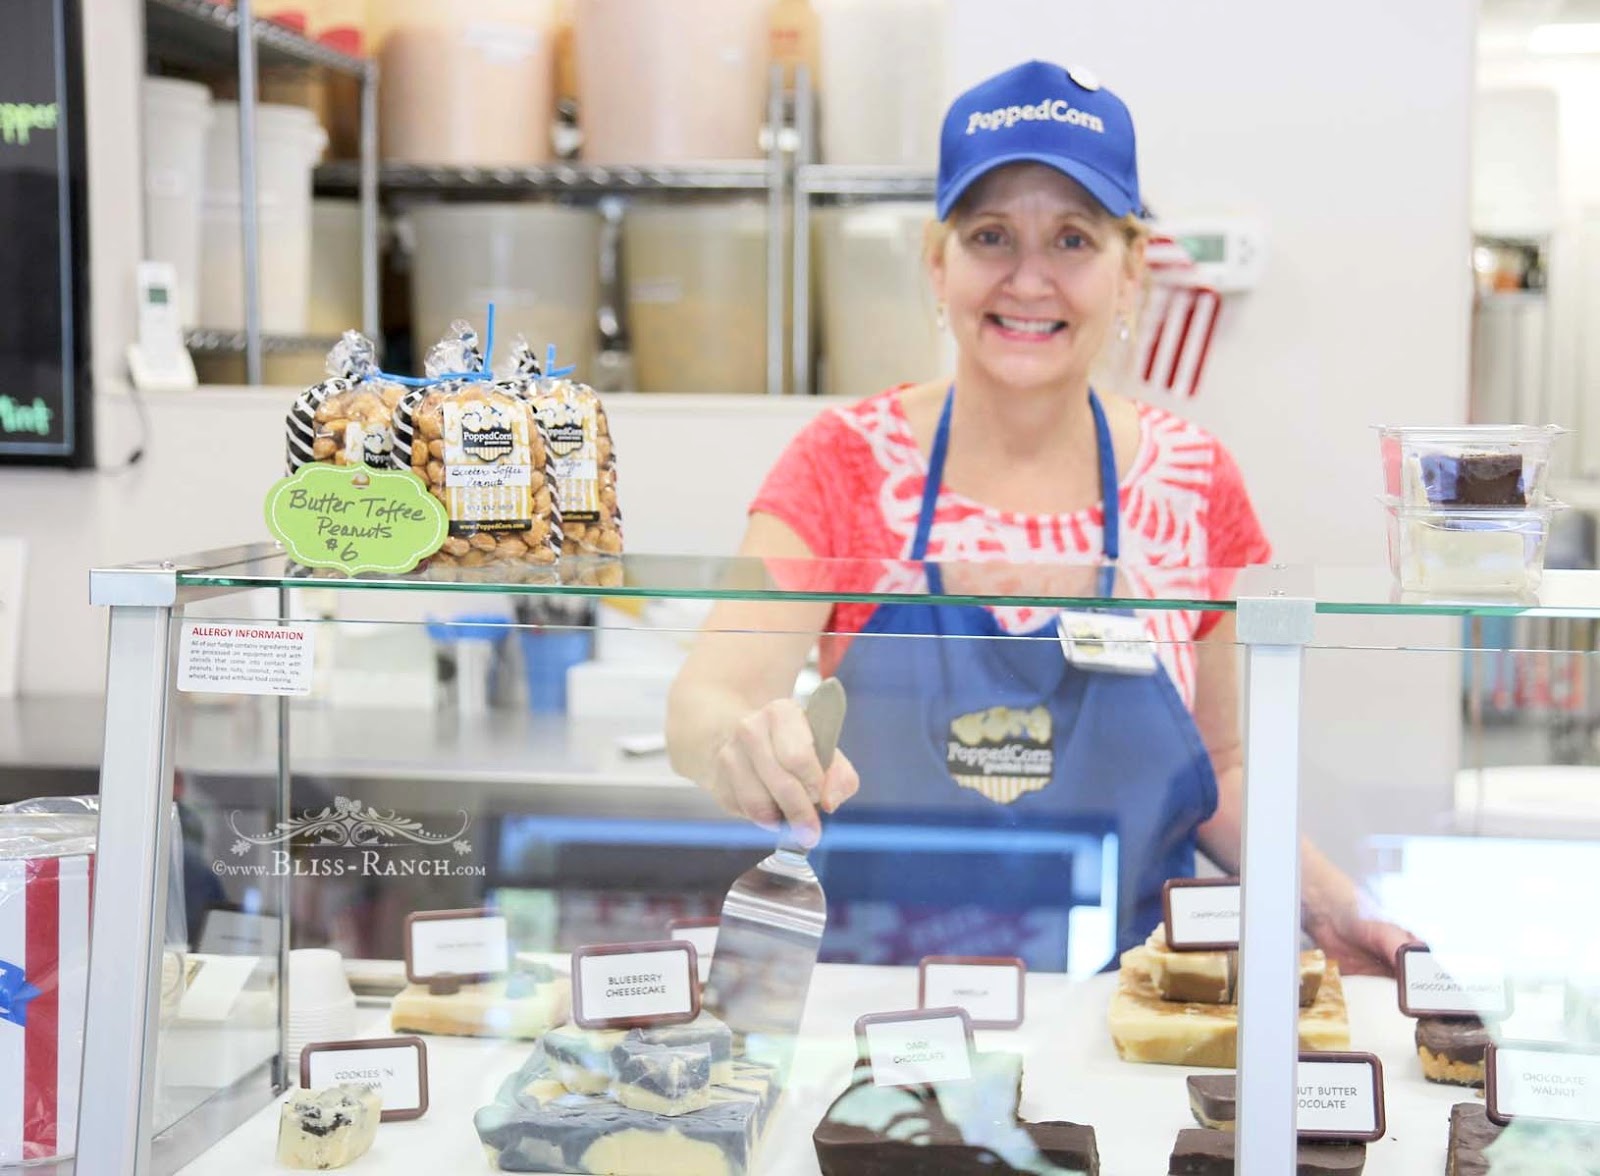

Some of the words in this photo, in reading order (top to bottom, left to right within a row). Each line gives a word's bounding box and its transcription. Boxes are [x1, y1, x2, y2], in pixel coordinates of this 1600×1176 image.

[966, 98, 1105, 134] PoppedCorn
[0, 103, 57, 144] pper
[463, 431, 513, 442] PoppedCorn
[290, 489, 355, 513] Butter
[360, 498, 426, 523] Toffee
[317, 516, 393, 539] Peanuts
[192, 627, 233, 637] ALLERGY
[235, 629, 304, 640] INFORMATION
[948, 743, 1051, 766] PoppedCorn
[607, 974, 662, 985] BLUEBERRY
[605, 985, 667, 998] CHEESECAKE
[334, 1069, 380, 1080] COOKIES
[1522, 1072, 1586, 1085] CHOCOLATE
[1318, 1087, 1357, 1096] BUTTER
